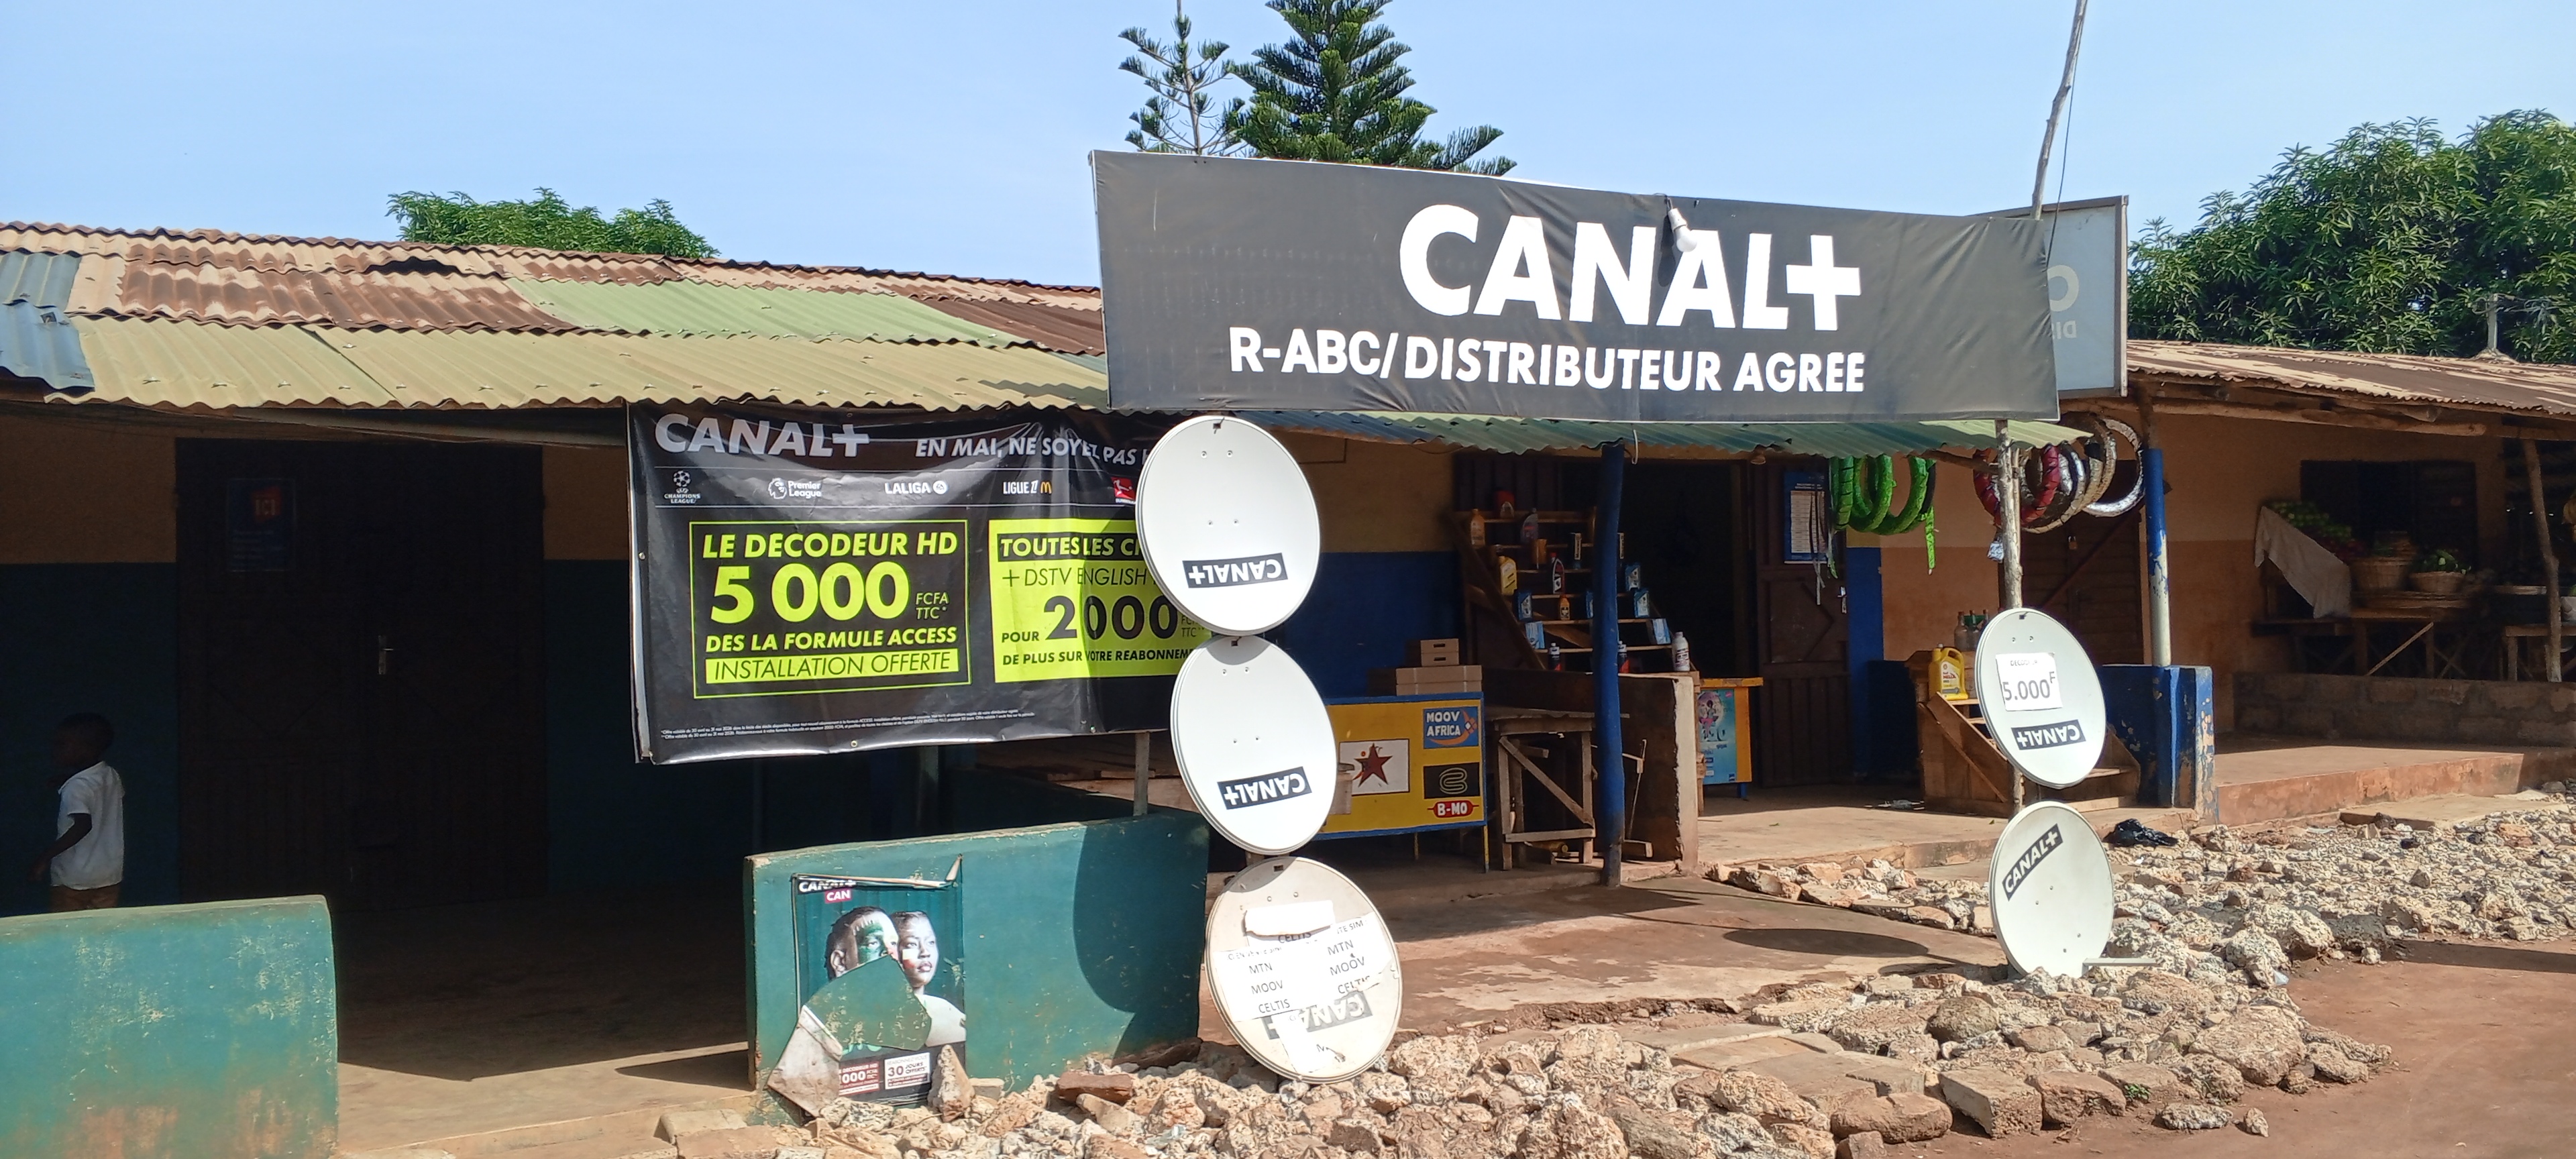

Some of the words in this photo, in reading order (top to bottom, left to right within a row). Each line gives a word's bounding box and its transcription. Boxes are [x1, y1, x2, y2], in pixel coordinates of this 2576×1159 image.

[1399, 203, 1861, 331] CANAL+
[1405, 336, 1722, 392] DISTRIBUTEUR
[1733, 351, 1865, 392] AGREE
[654, 413, 869, 457] CANAL+
[915, 439, 946, 457] EN
[951, 437, 1003, 458] MAI,
[1008, 437, 1037, 455] NE
[1042, 437, 1100, 460] SOYEZ
[1103, 447, 1137, 465] PAS
[788, 480, 822, 490] Premier
[788, 488, 822, 498] League
[884, 482, 932, 494] LALIGA
[1003, 481, 1030, 494] LIGUE
[702, 534, 737, 558] LE
[744, 532, 908, 558] DECODEUR
[917, 532, 958, 555] HD
[1001, 538, 1079, 557] TOUTES
[1083, 538, 1114, 556] LES
[1024, 567, 1072, 587] DSTV
[1077, 567, 1147, 586] ENGLISH
[1188, 558, 1282, 587] CANAL+
[710, 565, 755, 624] 5
[771, 561, 910, 622] 000
[916, 592, 950, 605] FCFA
[706, 634, 745, 653] DES
[751, 632, 778, 651] LA
[784, 629, 883, 650] FORMULE
[888, 626, 958, 646] ACCESS
[1002, 632, 1040, 643] POUR
[715, 655, 865, 680] INSTALLATION
[871, 651, 951, 673] OFFERTE
[1002, 655, 1019, 665] DE
[1023, 652, 1055, 664] PLUS
[1058, 651, 1083, 662] SUR
[1085, 650, 1113, 661] VOTRE
[1426, 710, 1460, 723] MOOV
[1426, 725, 1462, 737] AFRICA
[2016, 724, 2081, 747] CANAL+
[1223, 773, 1306, 806] CANAL+
[1437, 802, 1468, 816] B-MO
[2004, 829, 2059, 893] CANAL+
[826, 889, 851, 901] CAN
[1327, 939, 1354, 956] MTN
[1248, 962, 1273, 975] MTN
[1330, 956, 1366, 976] MOOV
[1250, 980, 1284, 995] MOOV
[1258, 999, 1291, 1013] CELTIS
[888, 1065, 904, 1077] 30
